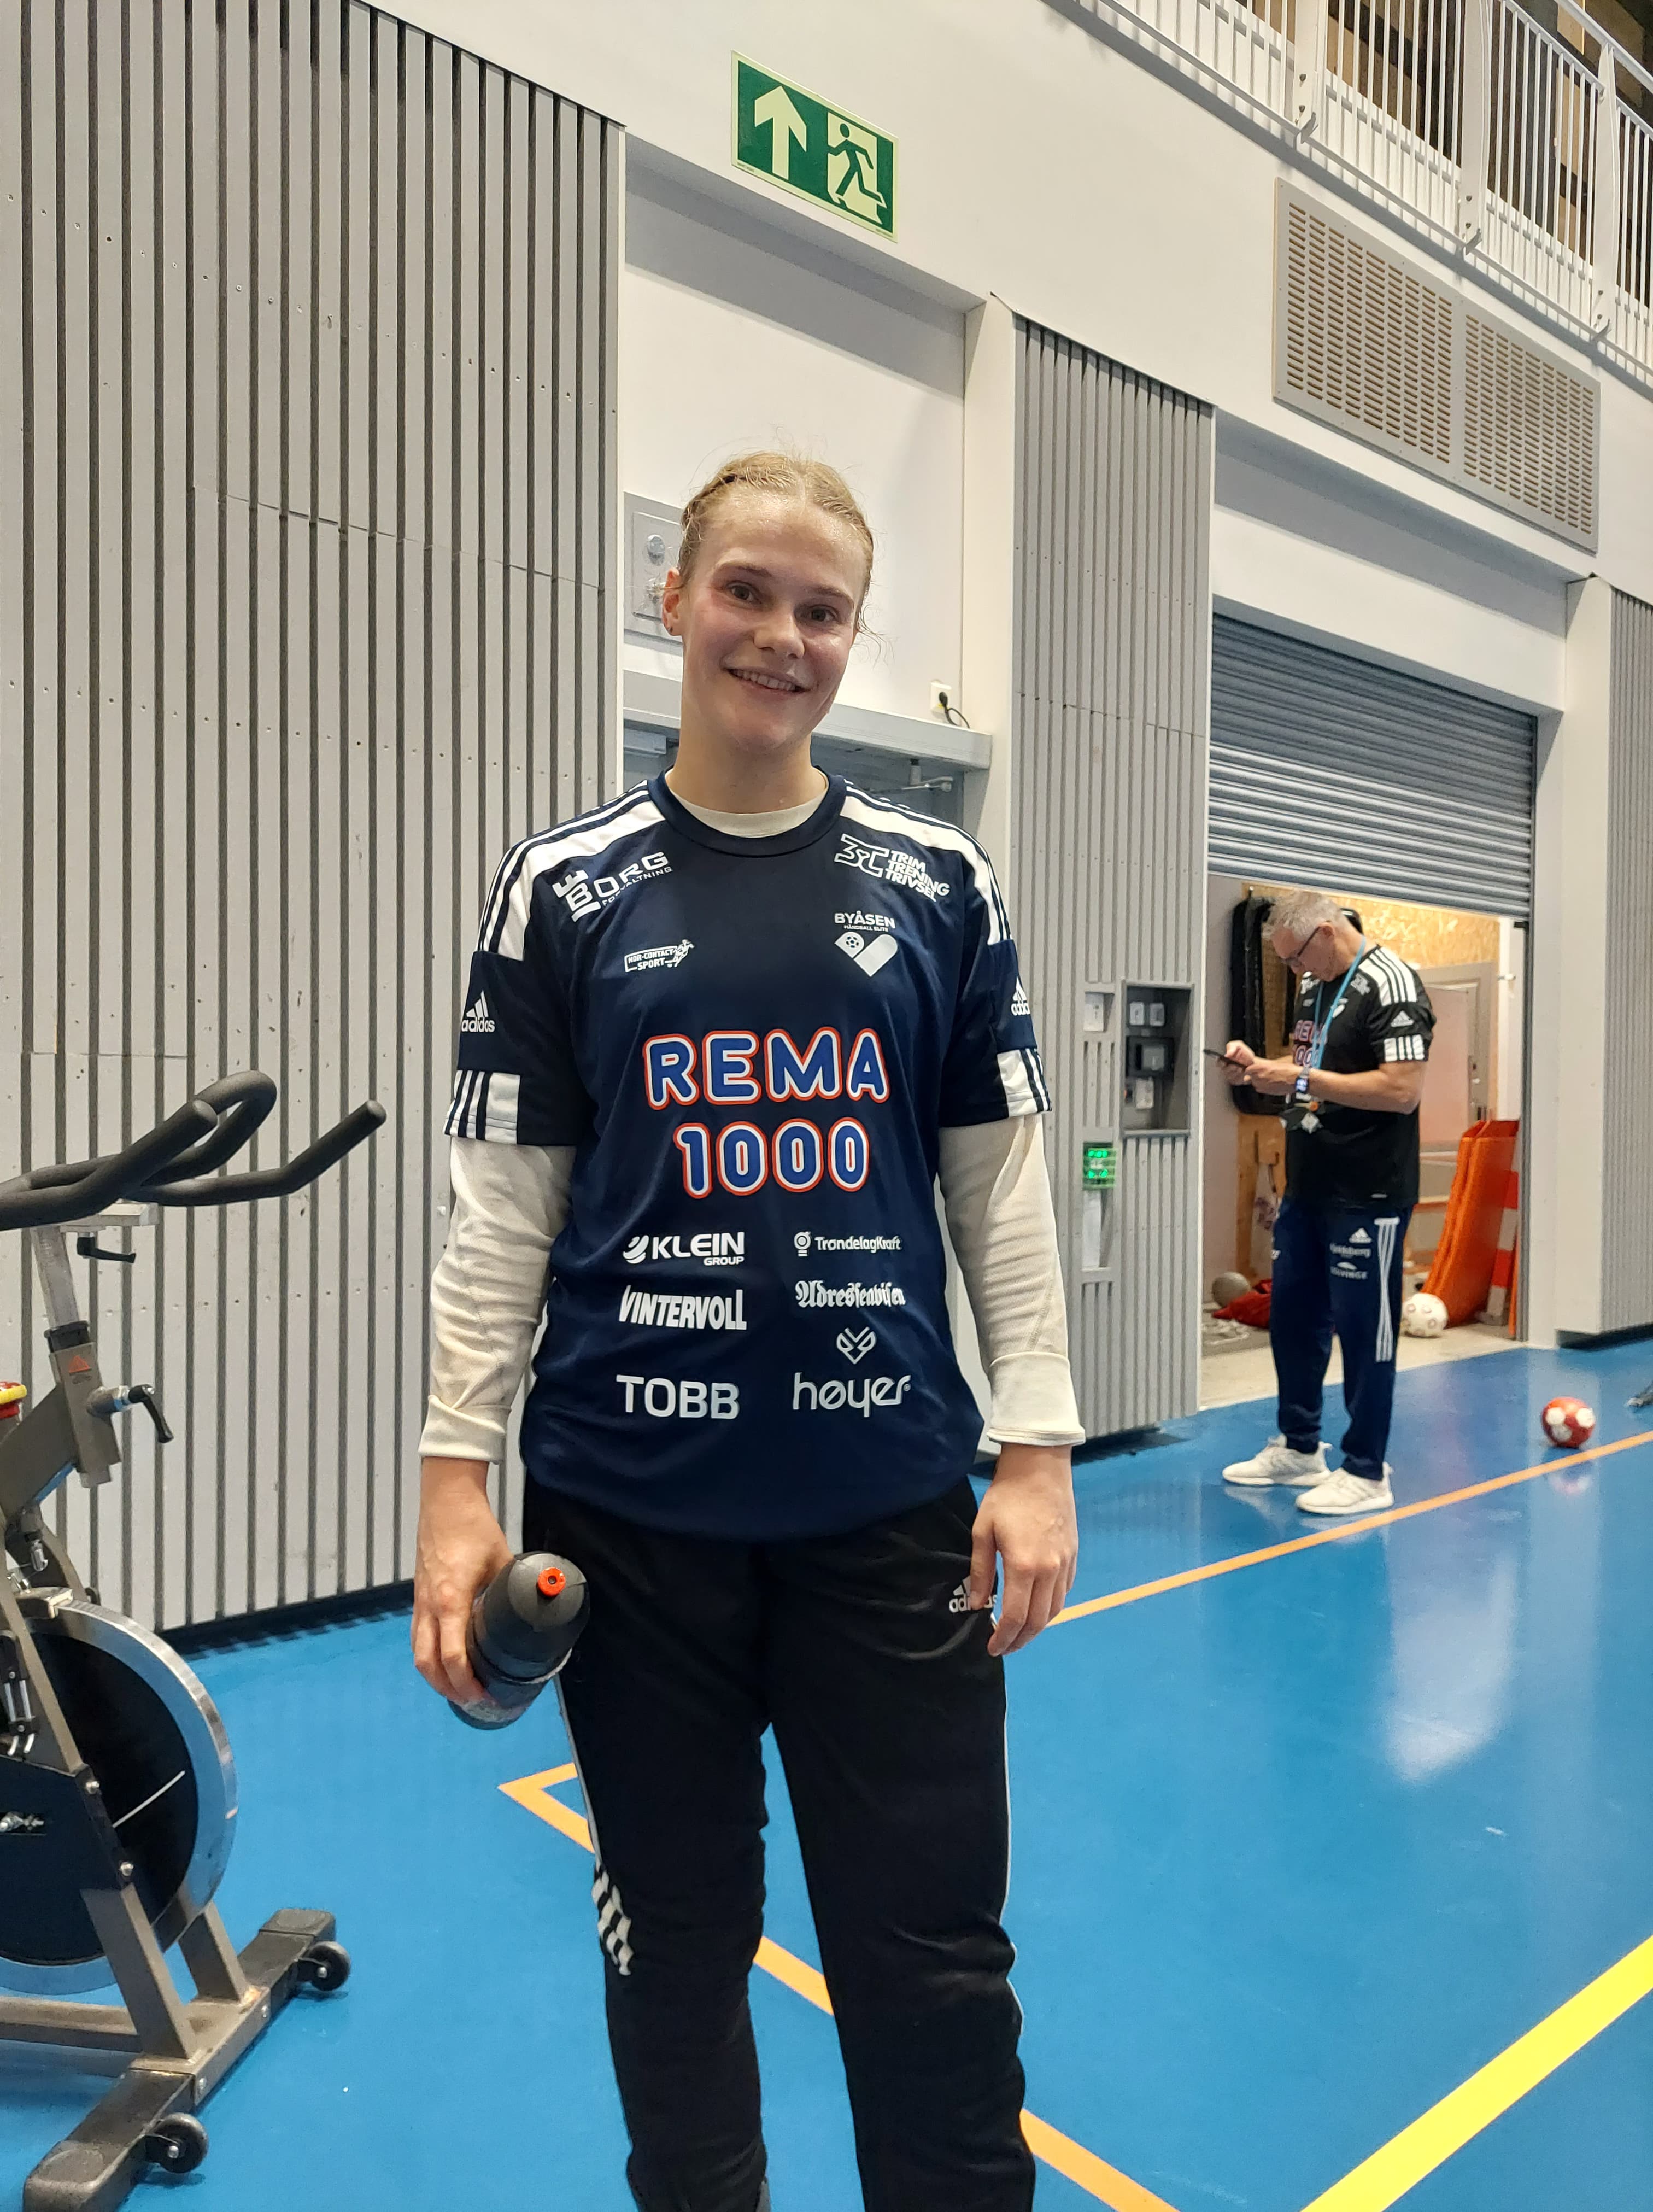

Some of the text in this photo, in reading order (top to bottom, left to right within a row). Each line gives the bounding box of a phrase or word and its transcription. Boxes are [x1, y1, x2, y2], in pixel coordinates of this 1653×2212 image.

[890, 850, 926, 873] TRIM
[884, 868, 936, 902] TRIVSEL
[888, 859, 951, 896] TRENING
[834, 910, 896, 929] BYÅSEN
[637, 957, 666, 971] SPORT
[461, 1016, 495, 1033] adidas
[643, 1027, 890, 1110] REMA
[673, 1117, 870, 1199] 1000
[652, 1232, 745, 1260] KLEIN
[704, 1256, 745, 1266] GROUP
[619, 1285, 747, 1330] VINTERVOLL
[616, 1374, 740, 1419] TOBB
